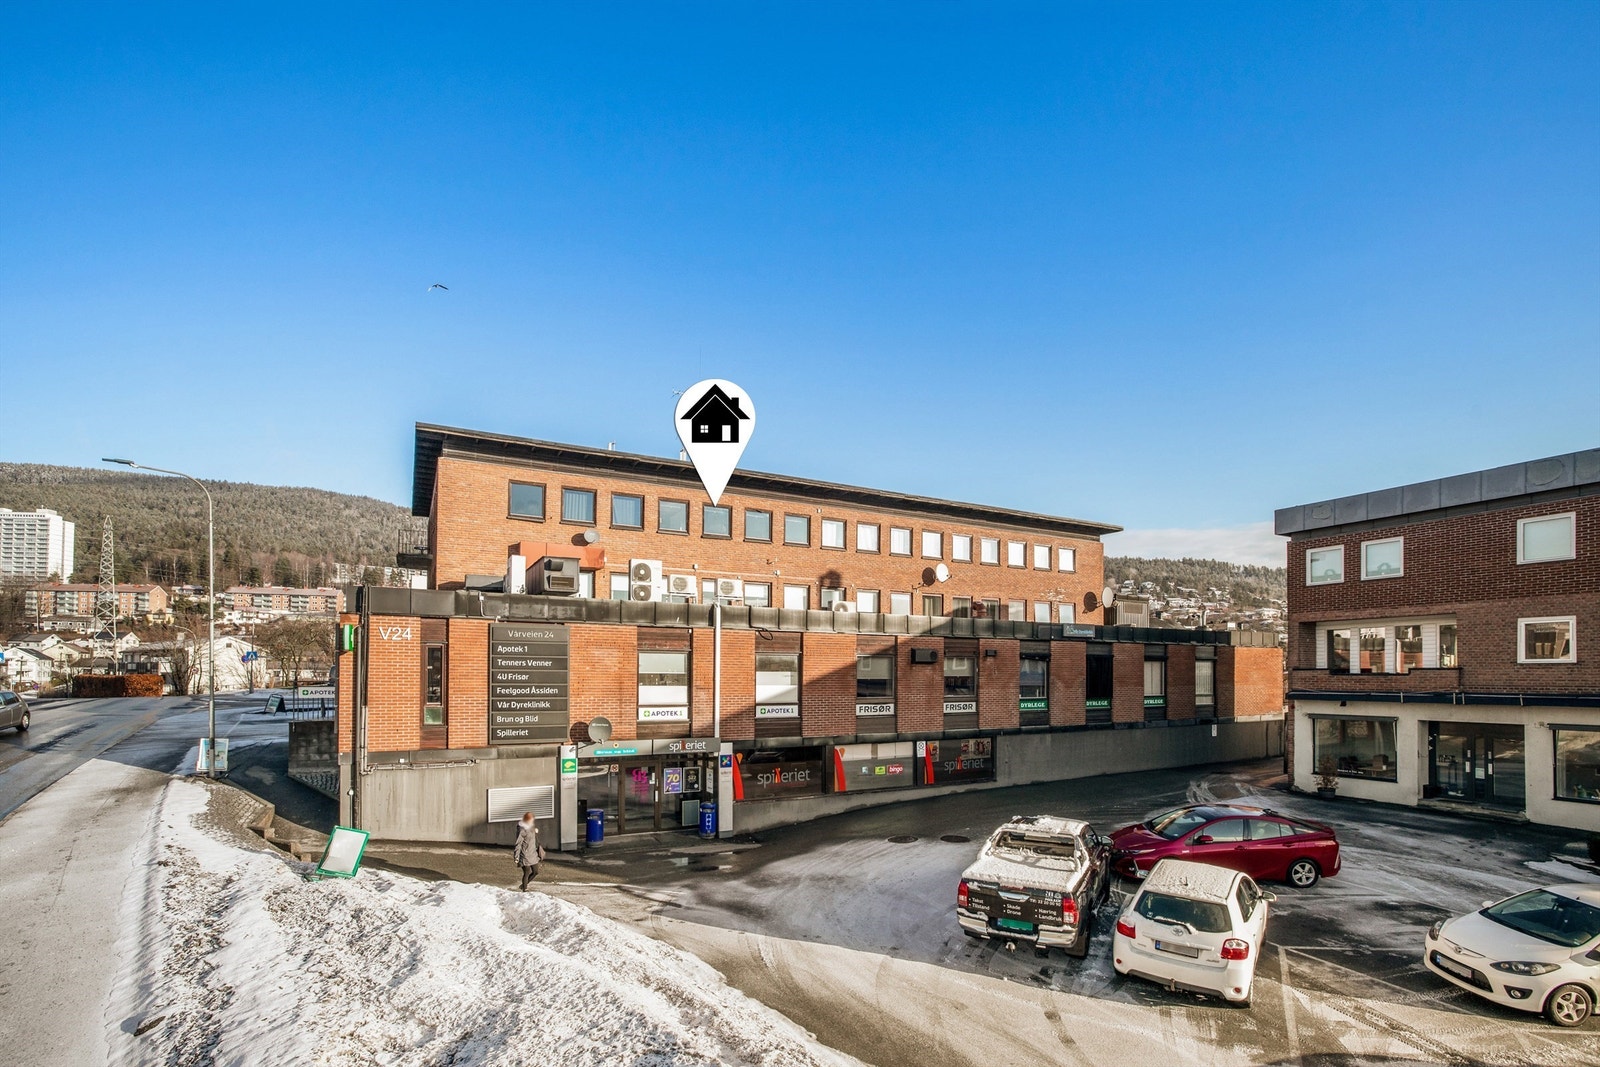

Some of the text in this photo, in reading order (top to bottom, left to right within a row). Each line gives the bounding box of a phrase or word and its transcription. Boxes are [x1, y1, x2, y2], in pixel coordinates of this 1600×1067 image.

[378, 626, 412, 641] V24
[497, 645, 524, 653] Apotek
[527, 659, 553, 667] Venner
[496, 686, 559, 696] Feelgood Åssiden
[497, 701, 551, 710] Vår Dyreklinikk
[858, 704, 891, 714] FRISØR
[945, 703, 974, 712] FRISØR
[497, 715, 514, 723] Brun
[525, 715, 539, 723] Blid
[496, 729, 529, 738] Spilleriet
[889, 765, 904, 774] bingo
[667, 774, 680, 783] 70
[972, 903, 990, 911] Tilstand
[1038, 914, 1063, 922] Landbruk
